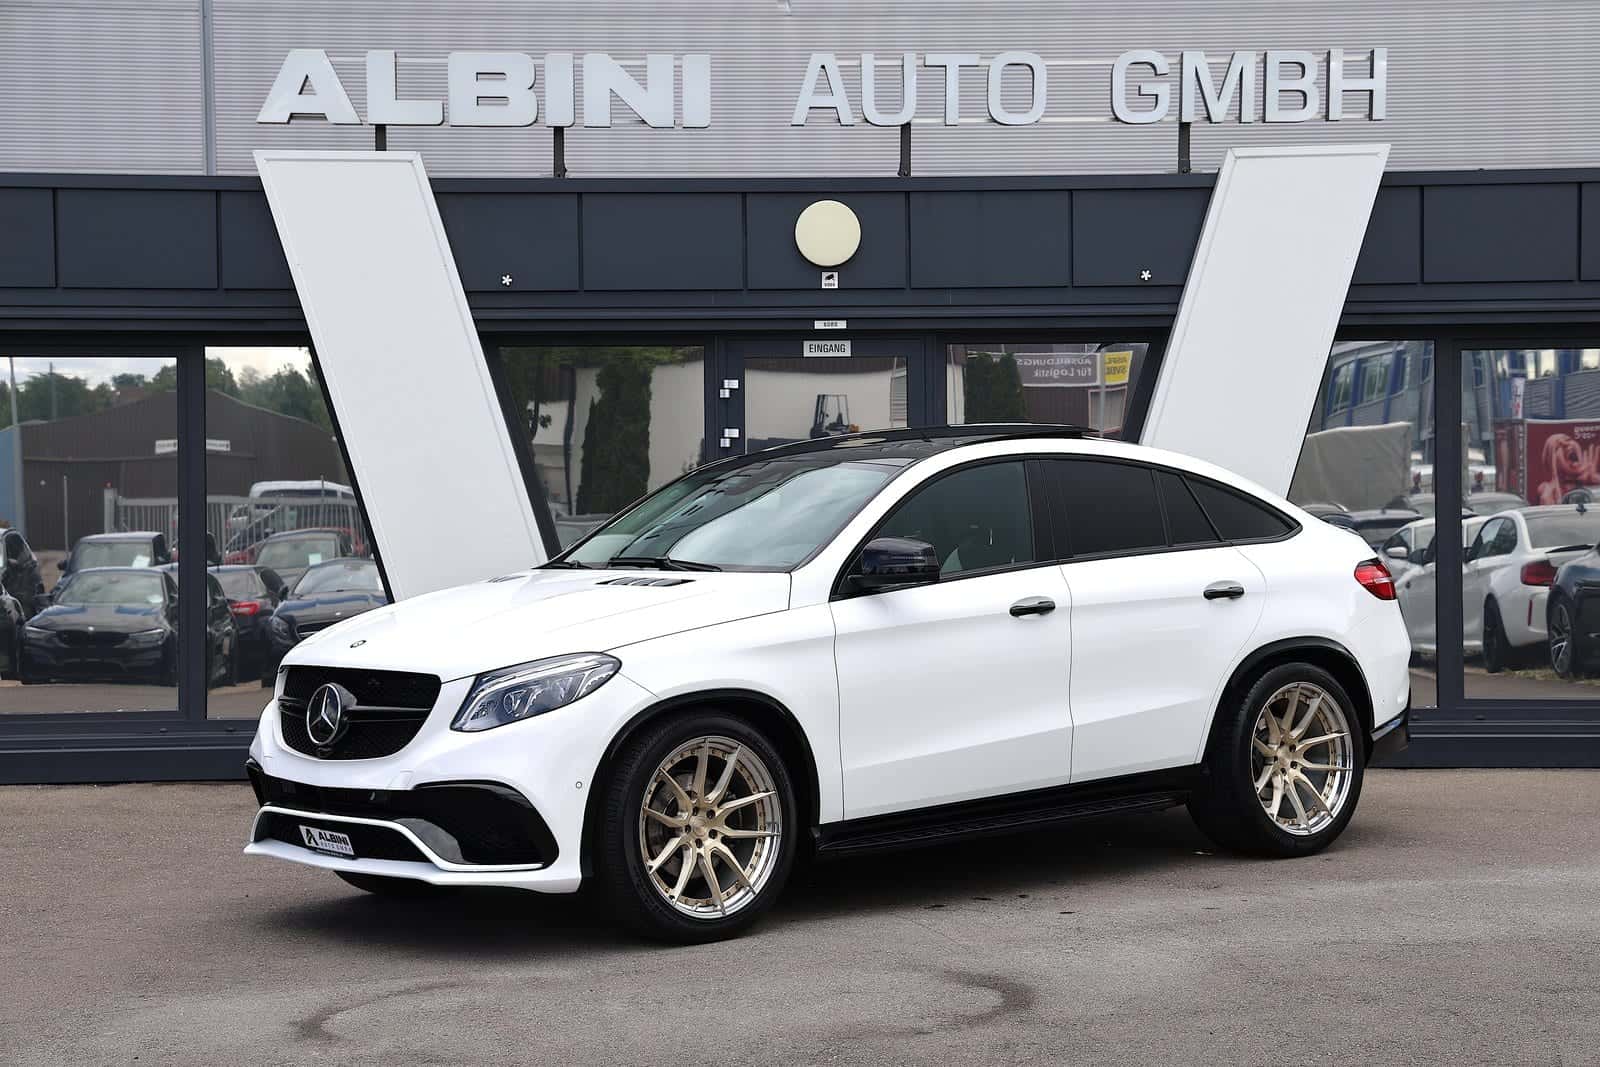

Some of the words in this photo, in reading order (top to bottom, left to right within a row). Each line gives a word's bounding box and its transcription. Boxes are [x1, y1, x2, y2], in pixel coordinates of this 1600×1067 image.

[256, 48, 712, 128] ALBINI
[790, 50, 1049, 127] AUTO
[1110, 47, 1389, 126] GMBH
[808, 343, 846, 353] EINGANG
[318, 831, 350, 846] ALBINI
